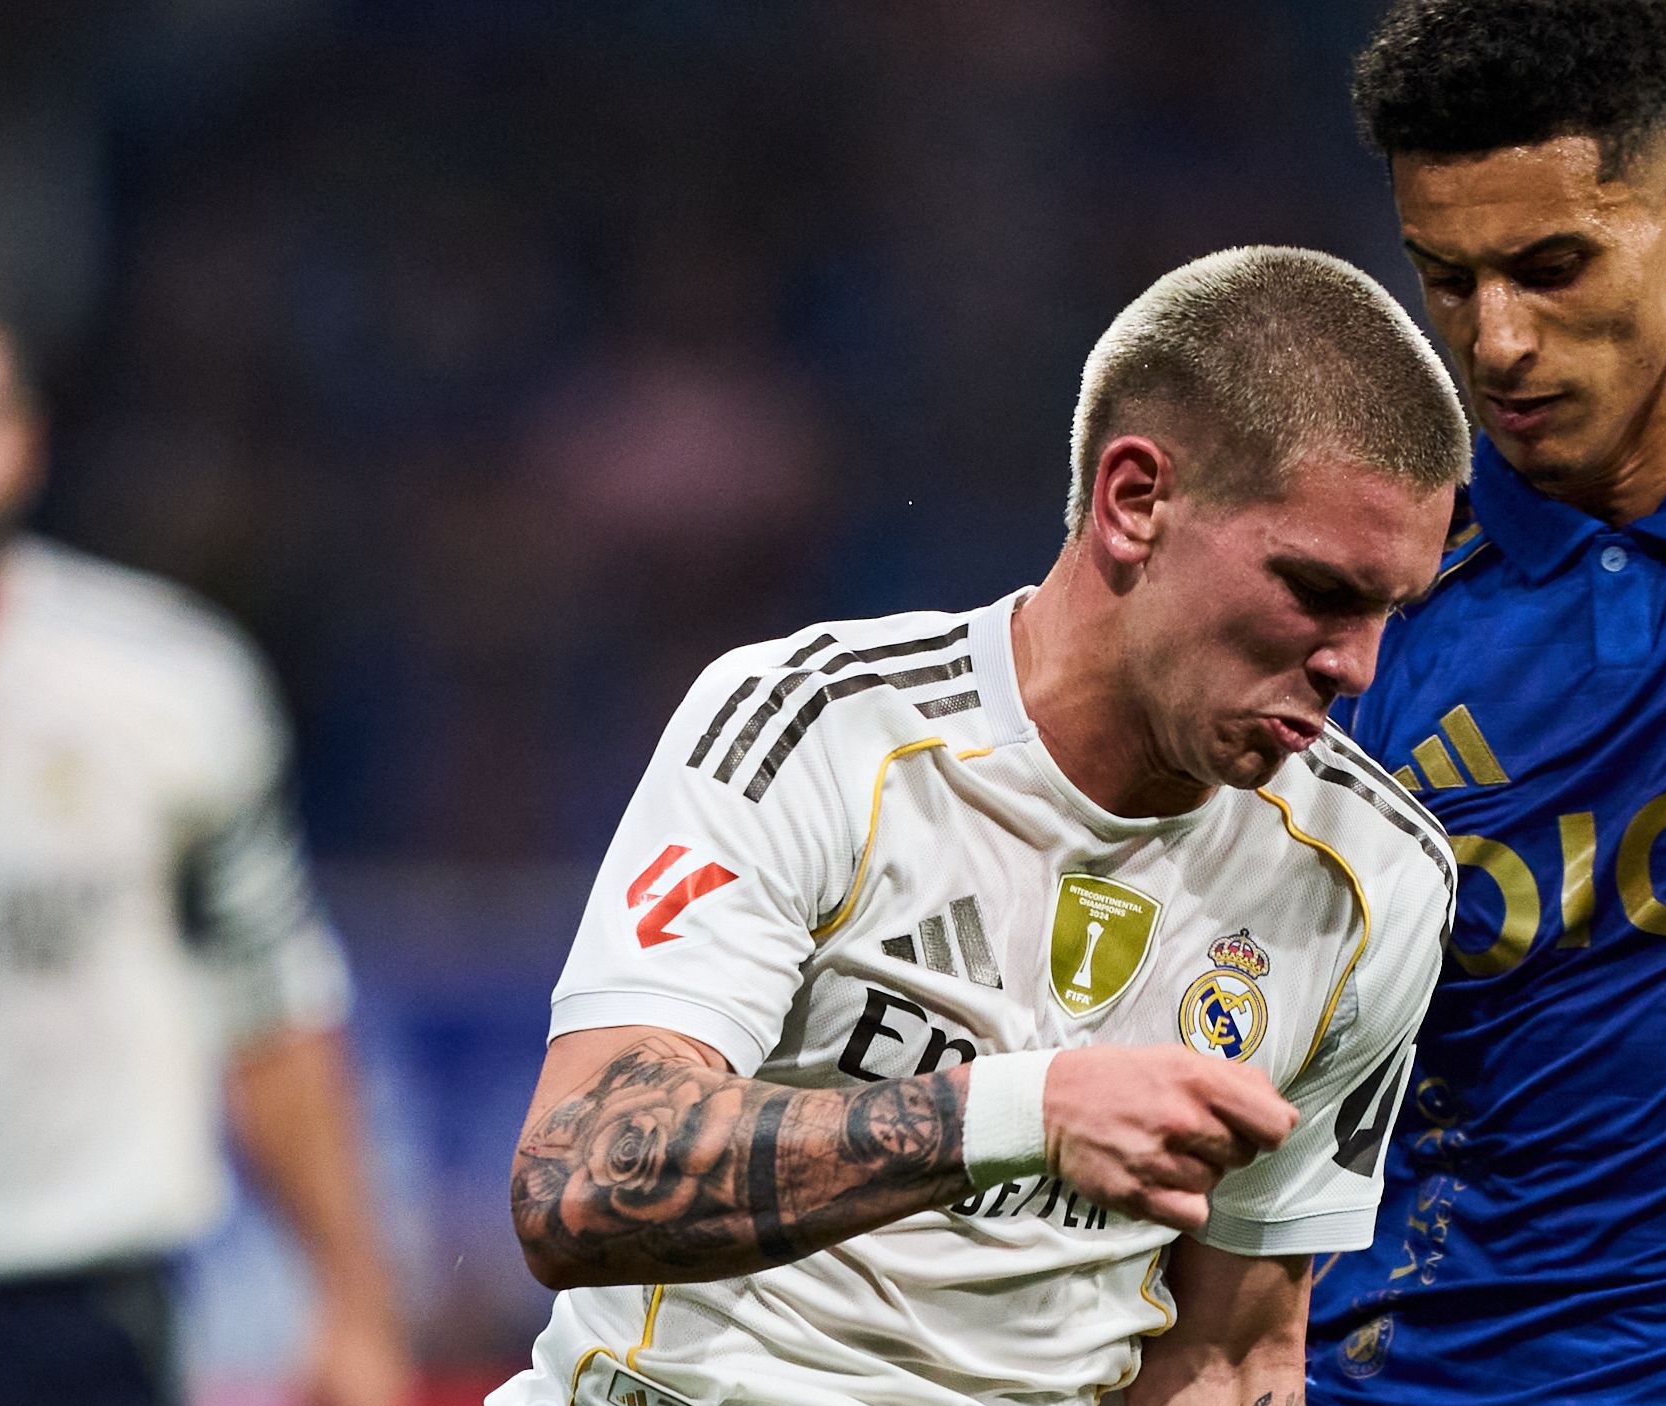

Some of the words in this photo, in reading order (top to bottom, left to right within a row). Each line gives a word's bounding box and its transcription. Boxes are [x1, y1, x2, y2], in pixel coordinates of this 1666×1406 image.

[1069, 885, 1144, 914] INTERCONTINENTAL
[1078, 896, 1126, 917] CHAMPIONS
[1089, 908, 1110, 921] 2024
